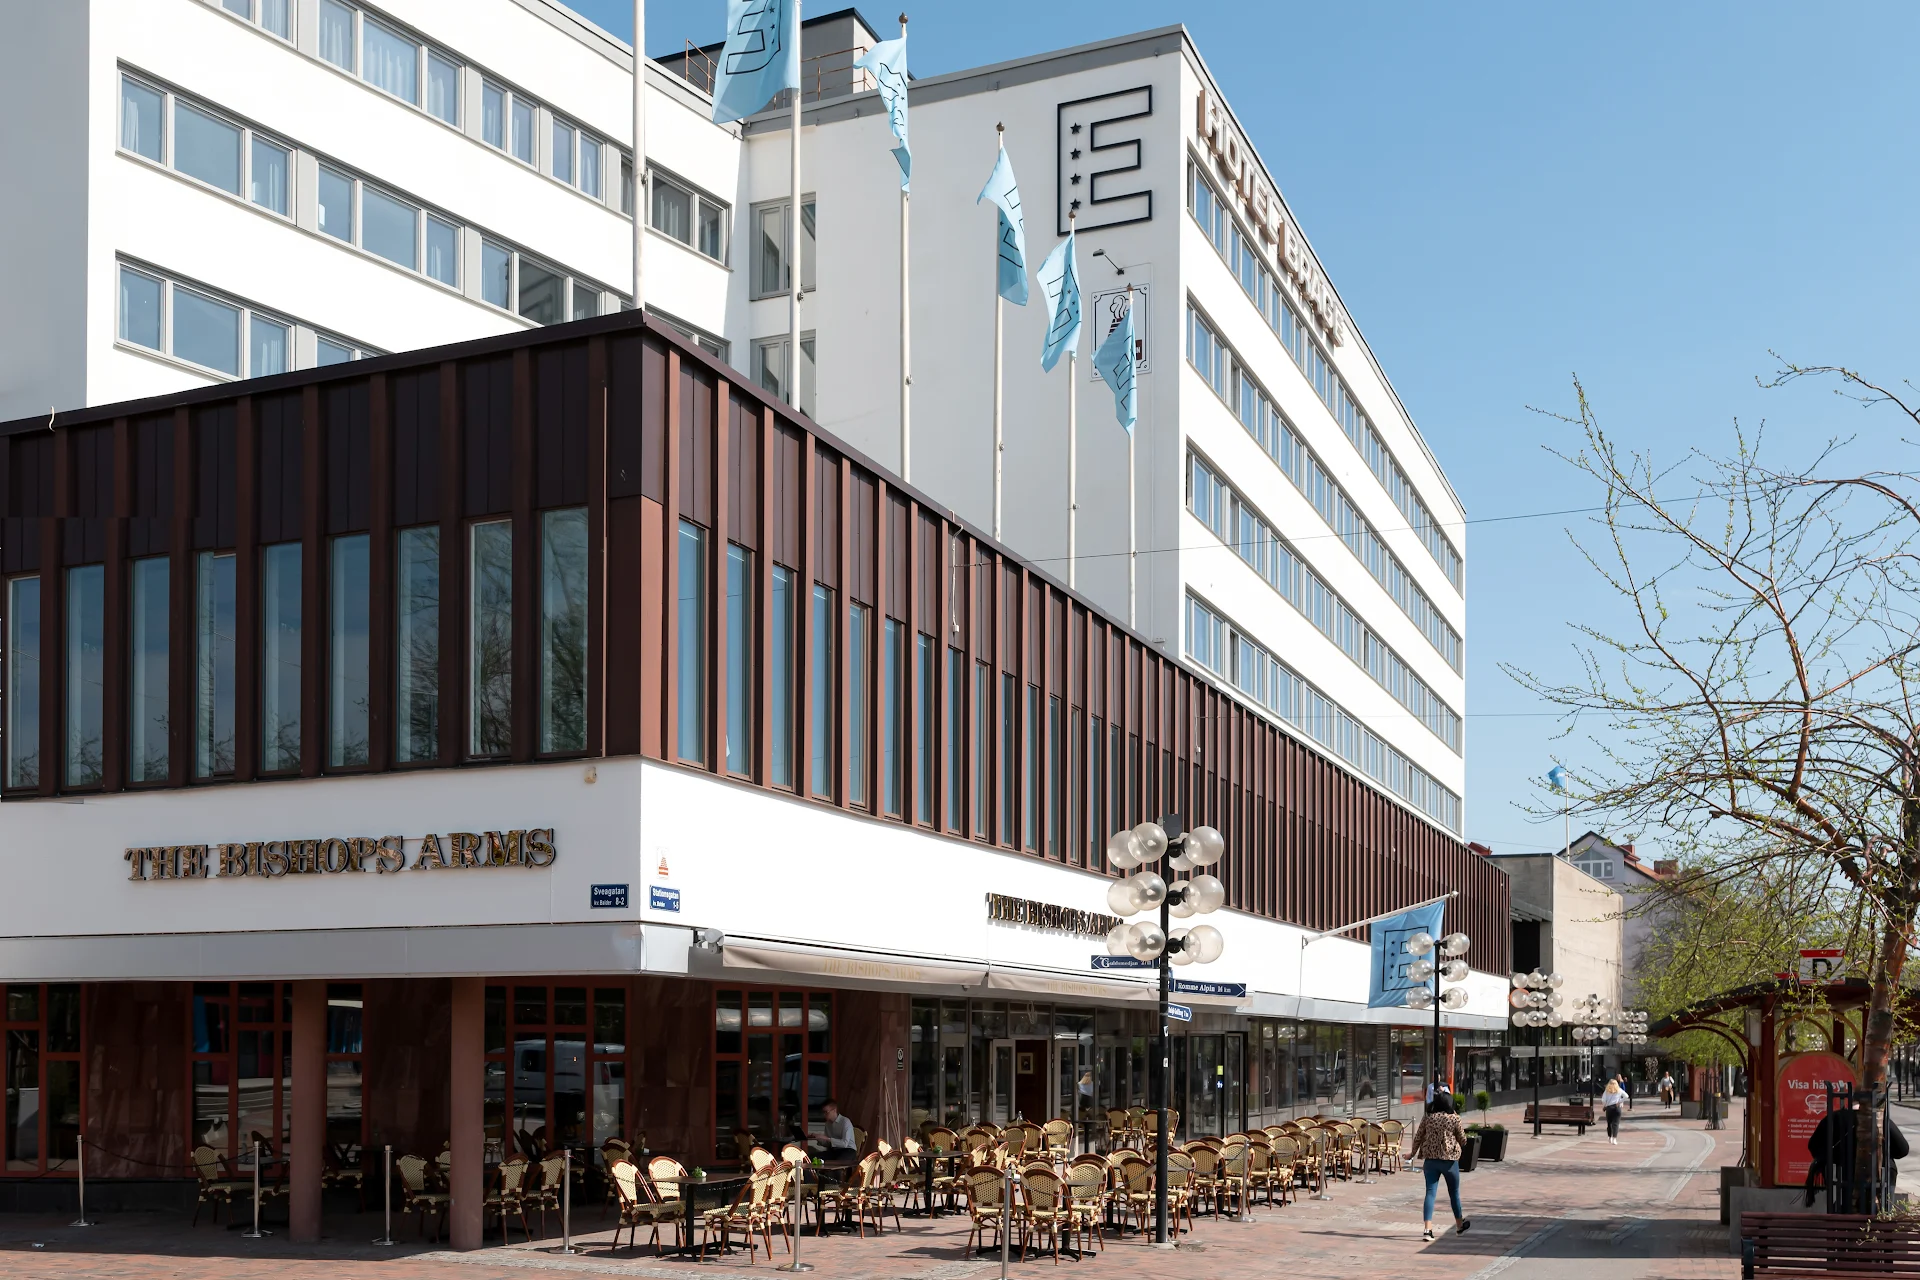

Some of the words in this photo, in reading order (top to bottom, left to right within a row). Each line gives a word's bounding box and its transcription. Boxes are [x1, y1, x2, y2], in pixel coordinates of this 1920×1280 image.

[1056, 84, 1153, 237] E
[1197, 89, 1283, 246] HOTEL
[1278, 220, 1345, 348] BRAGE
[124, 844, 209, 881] THE
[216, 835, 406, 879] BISHOPS
[410, 827, 556, 871] ARMS
[593, 887, 625, 897] Sveagatan
[985, 892, 1025, 924] THE
[1025, 899, 1088, 934] BISHOPS
[846, 960, 891, 977] BISHOPS
[1812, 958, 1833, 980] D
[1178, 982, 1199, 991] Romme
[1199, 984, 1216, 993] Alpin
[1788, 1079, 1810, 1090] Visa
